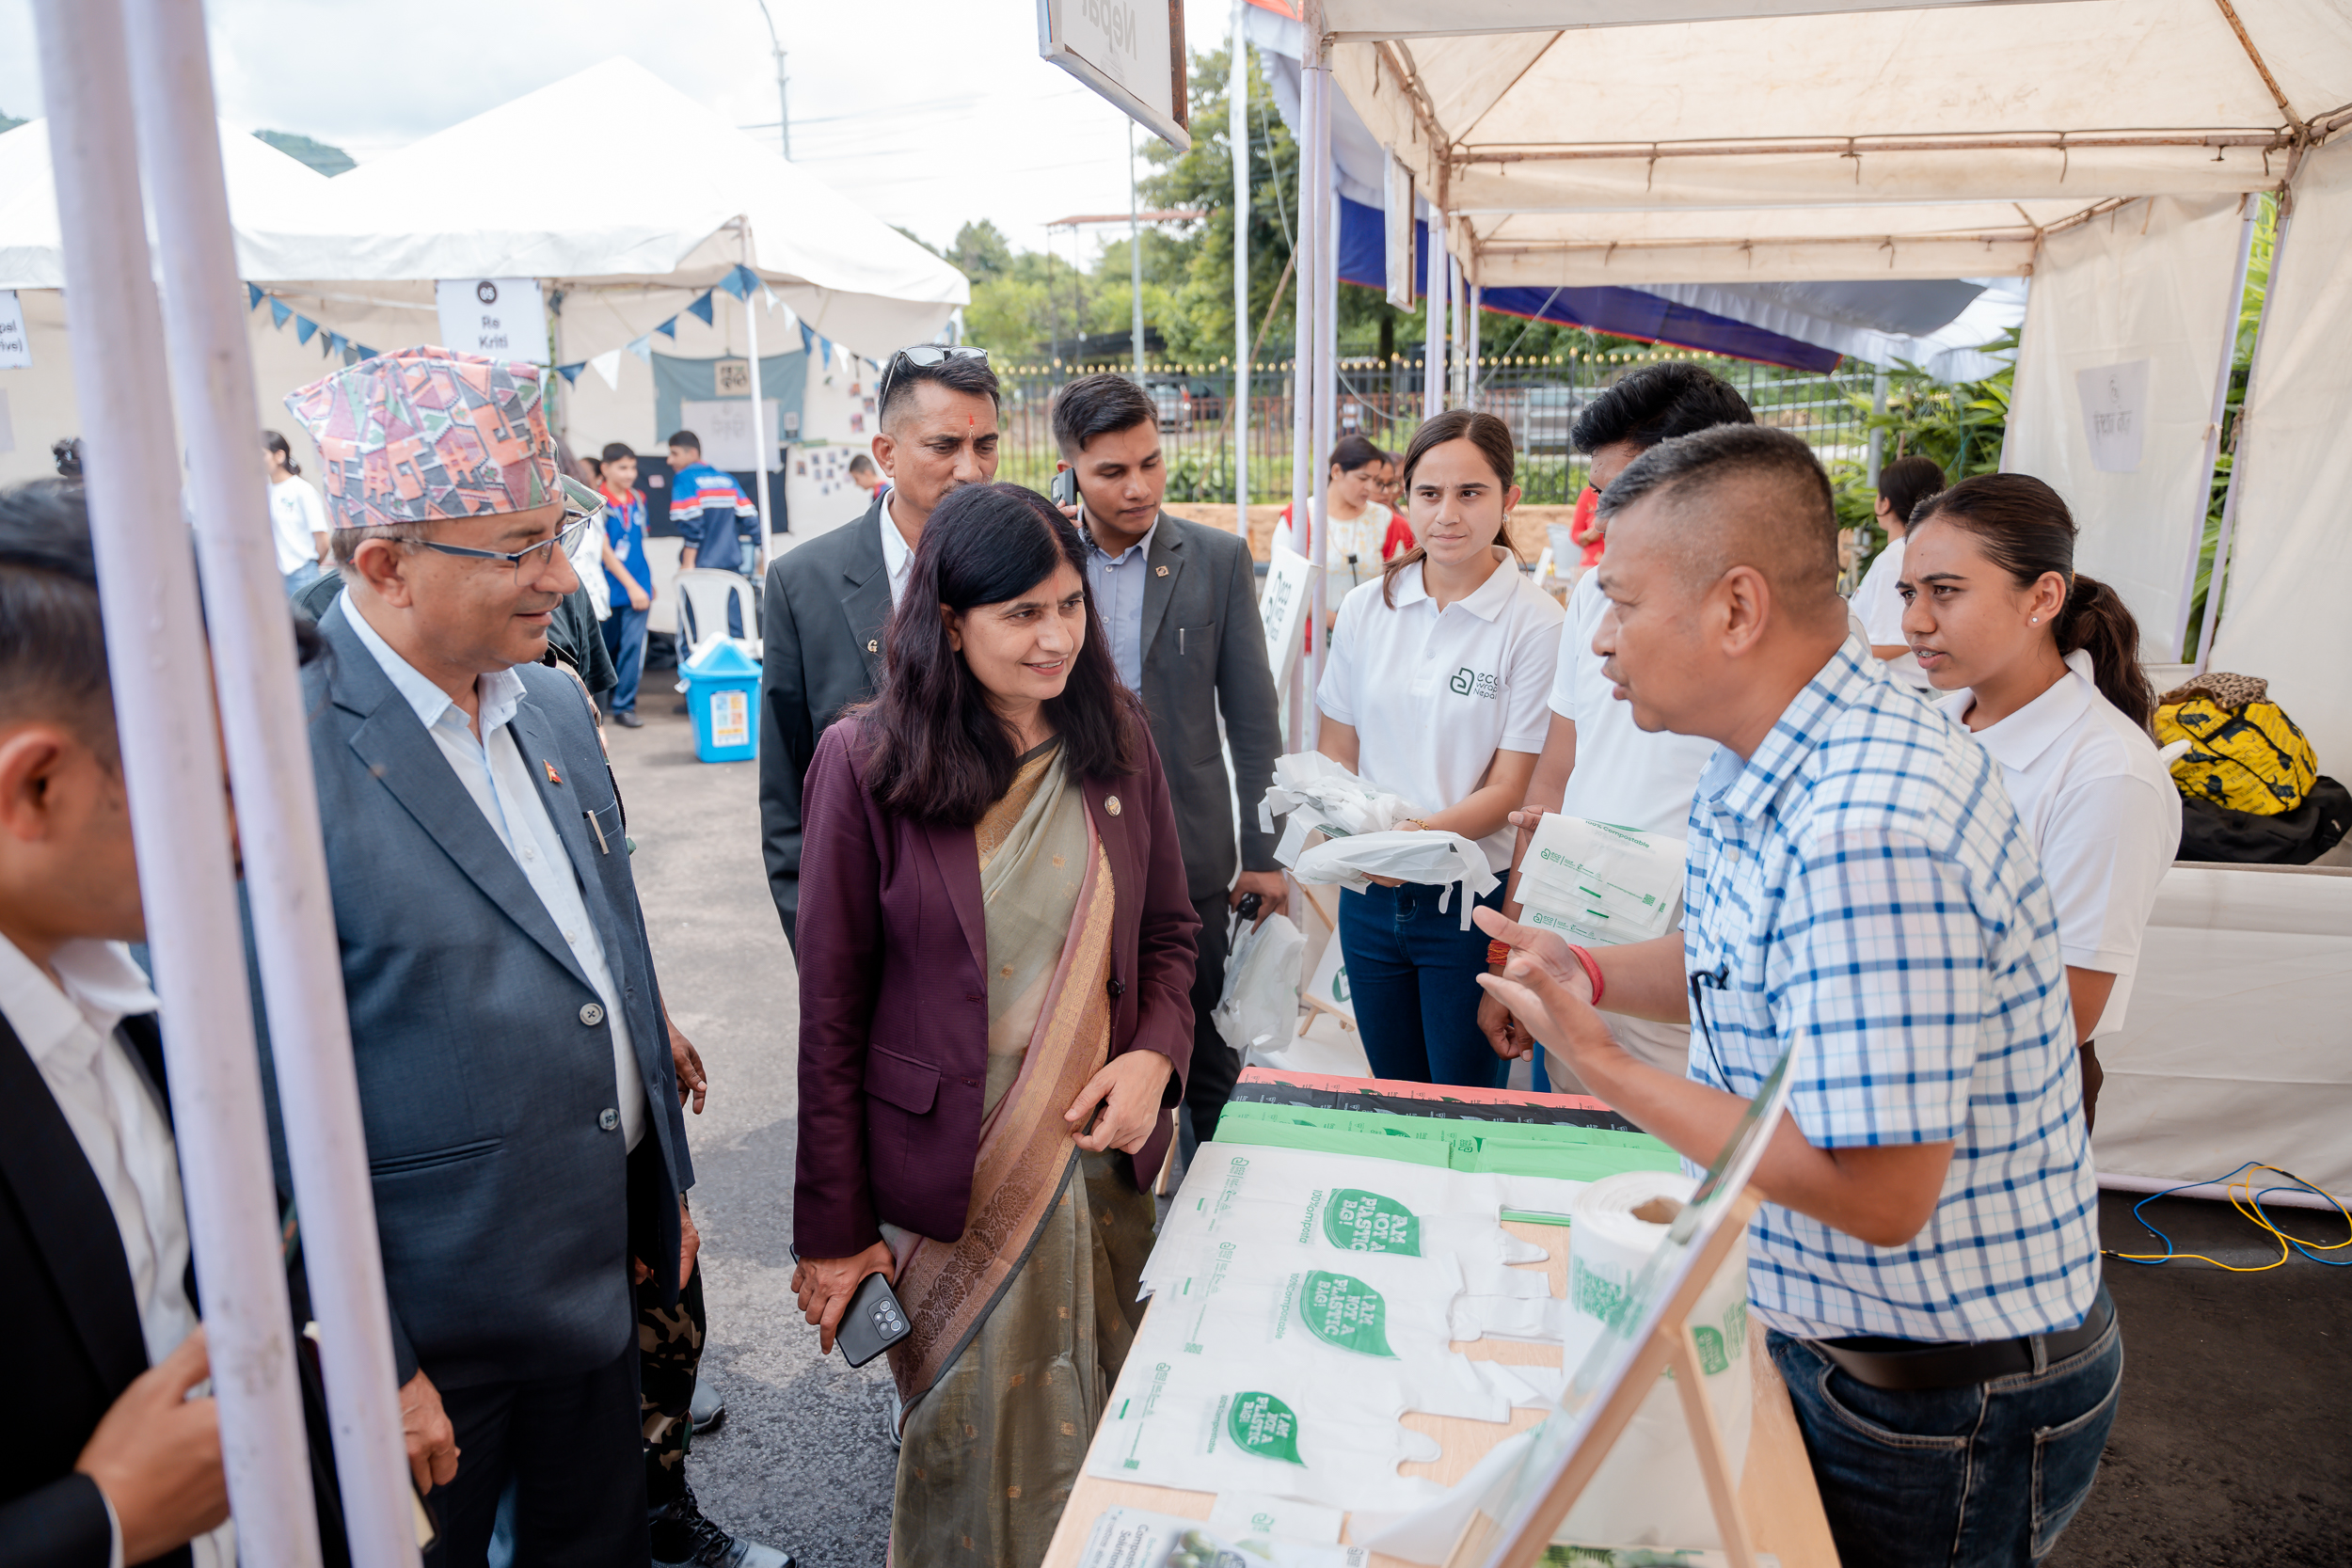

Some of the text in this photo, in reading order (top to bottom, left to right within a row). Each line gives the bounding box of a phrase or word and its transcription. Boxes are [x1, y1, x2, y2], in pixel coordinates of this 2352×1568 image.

[479, 287, 495, 301] 05
[482, 315, 500, 329] Re
[479, 334, 508, 350] Kriti
[1473, 688, 1498, 700] Nepal
[1603, 826, 1650, 848] Compostable
[1349, 1196, 1378, 1252] PLASTIC
[1312, 1280, 1331, 1307] BAG!
[1323, 1279, 1349, 1337] PLASTIC
[1340, 1295, 1361, 1336] NOT A
[1358, 1300, 1375, 1326] AM
[1247, 1396, 1269, 1446] PLASTIC
[1261, 1411, 1279, 1444] NOT A
[1276, 1418, 1291, 1439] AM
